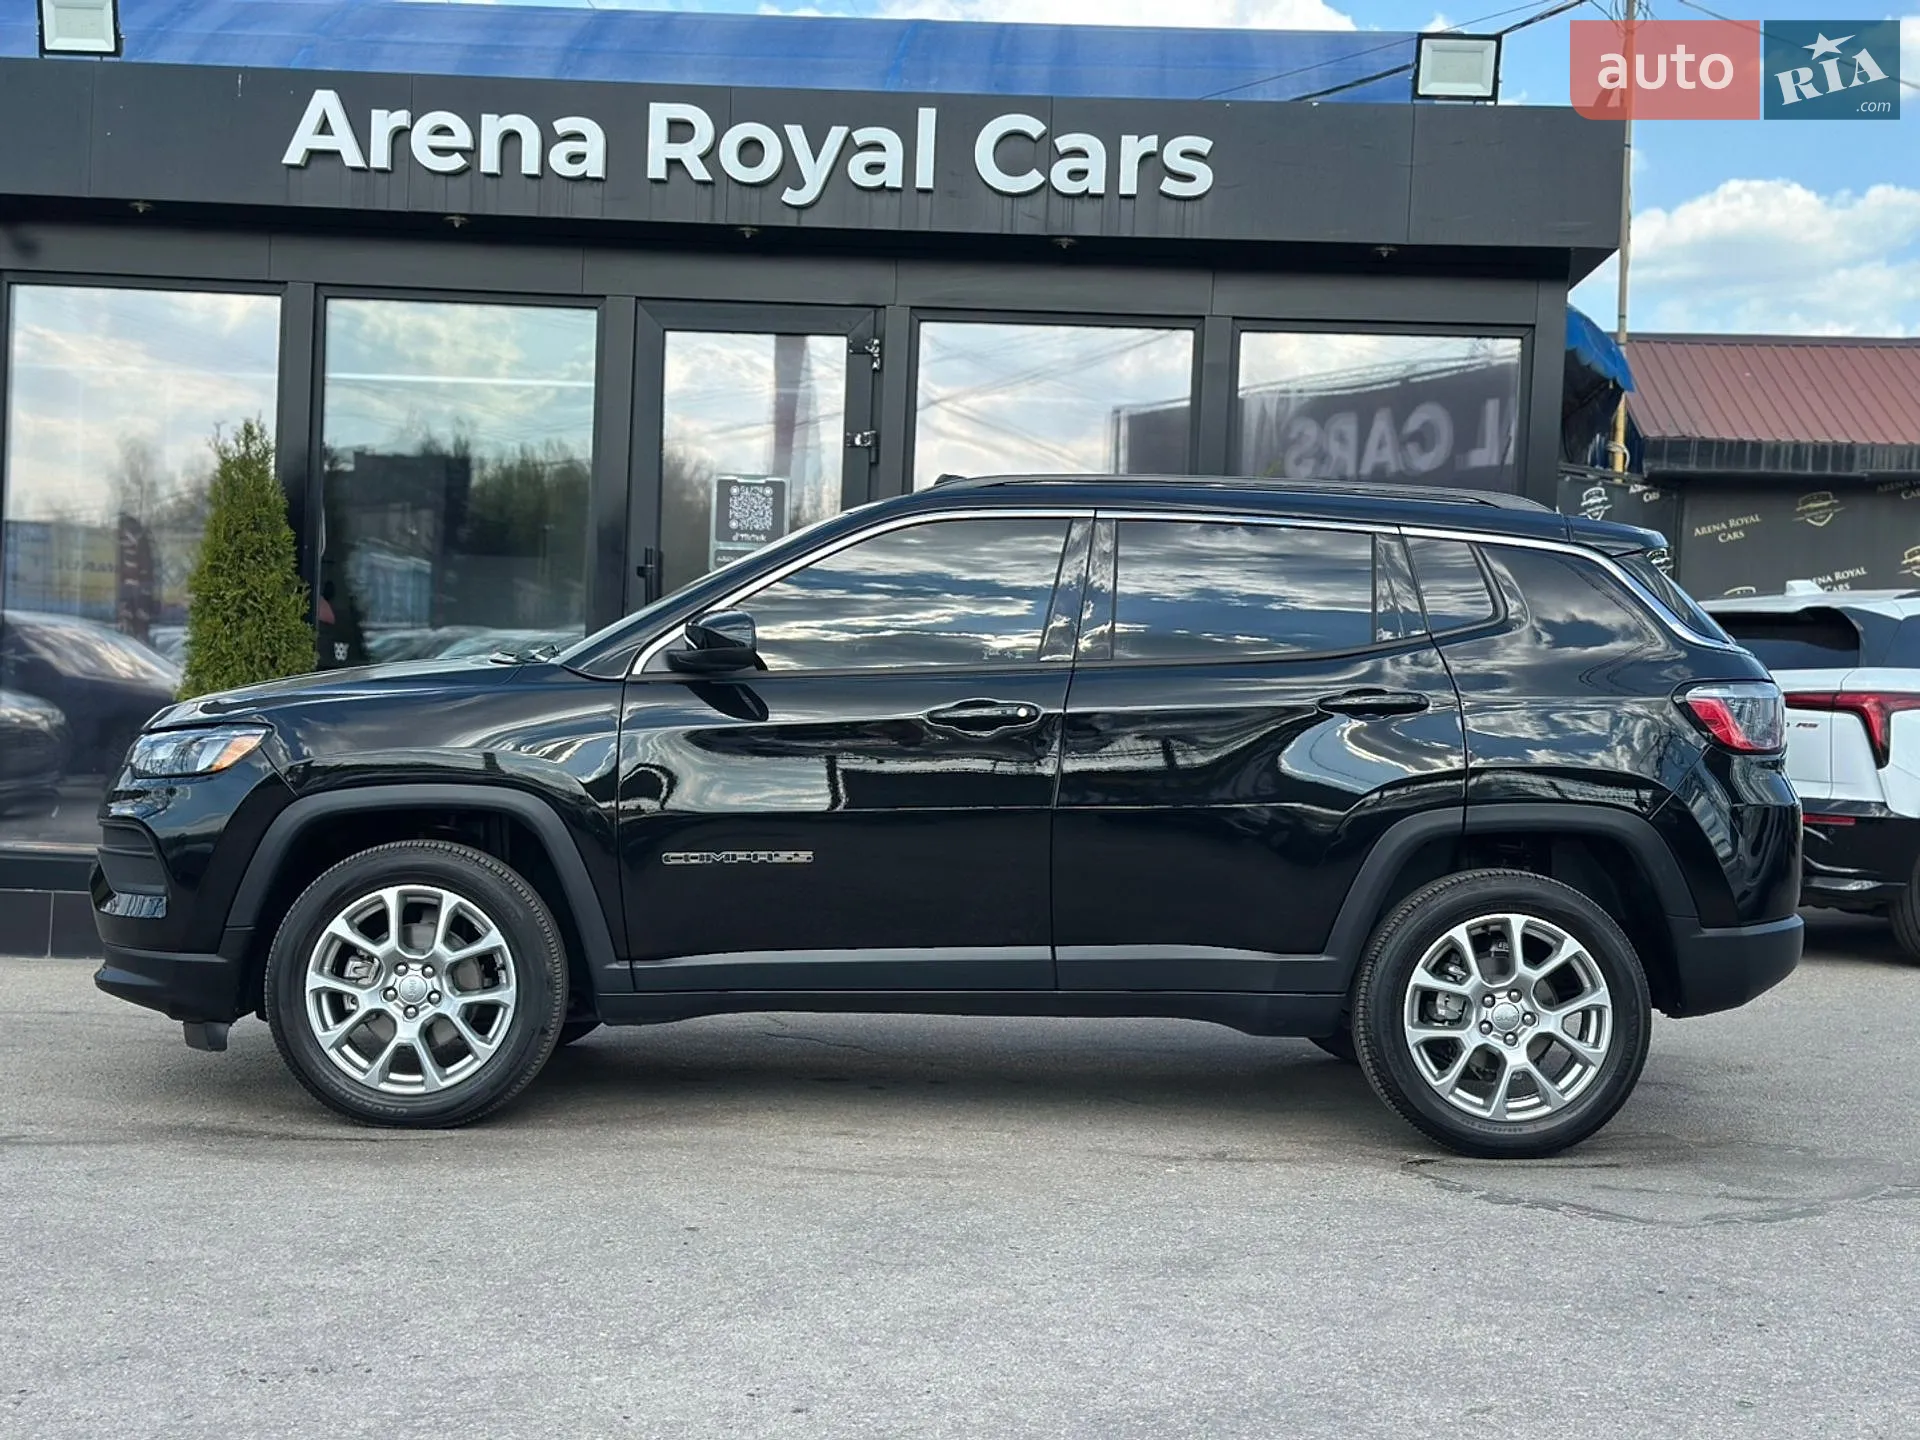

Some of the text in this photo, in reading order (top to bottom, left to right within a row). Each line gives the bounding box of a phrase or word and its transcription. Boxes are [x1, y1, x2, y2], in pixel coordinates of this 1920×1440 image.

[281, 89, 1214, 208] Arena Royal Cars
[1694, 513, 1762, 537] ARENA ROYAL
[1718, 530, 1745, 543] CARS
[1811, 566, 1868, 585] ENA ROYAL
[662, 850, 814, 865] COMPASS
